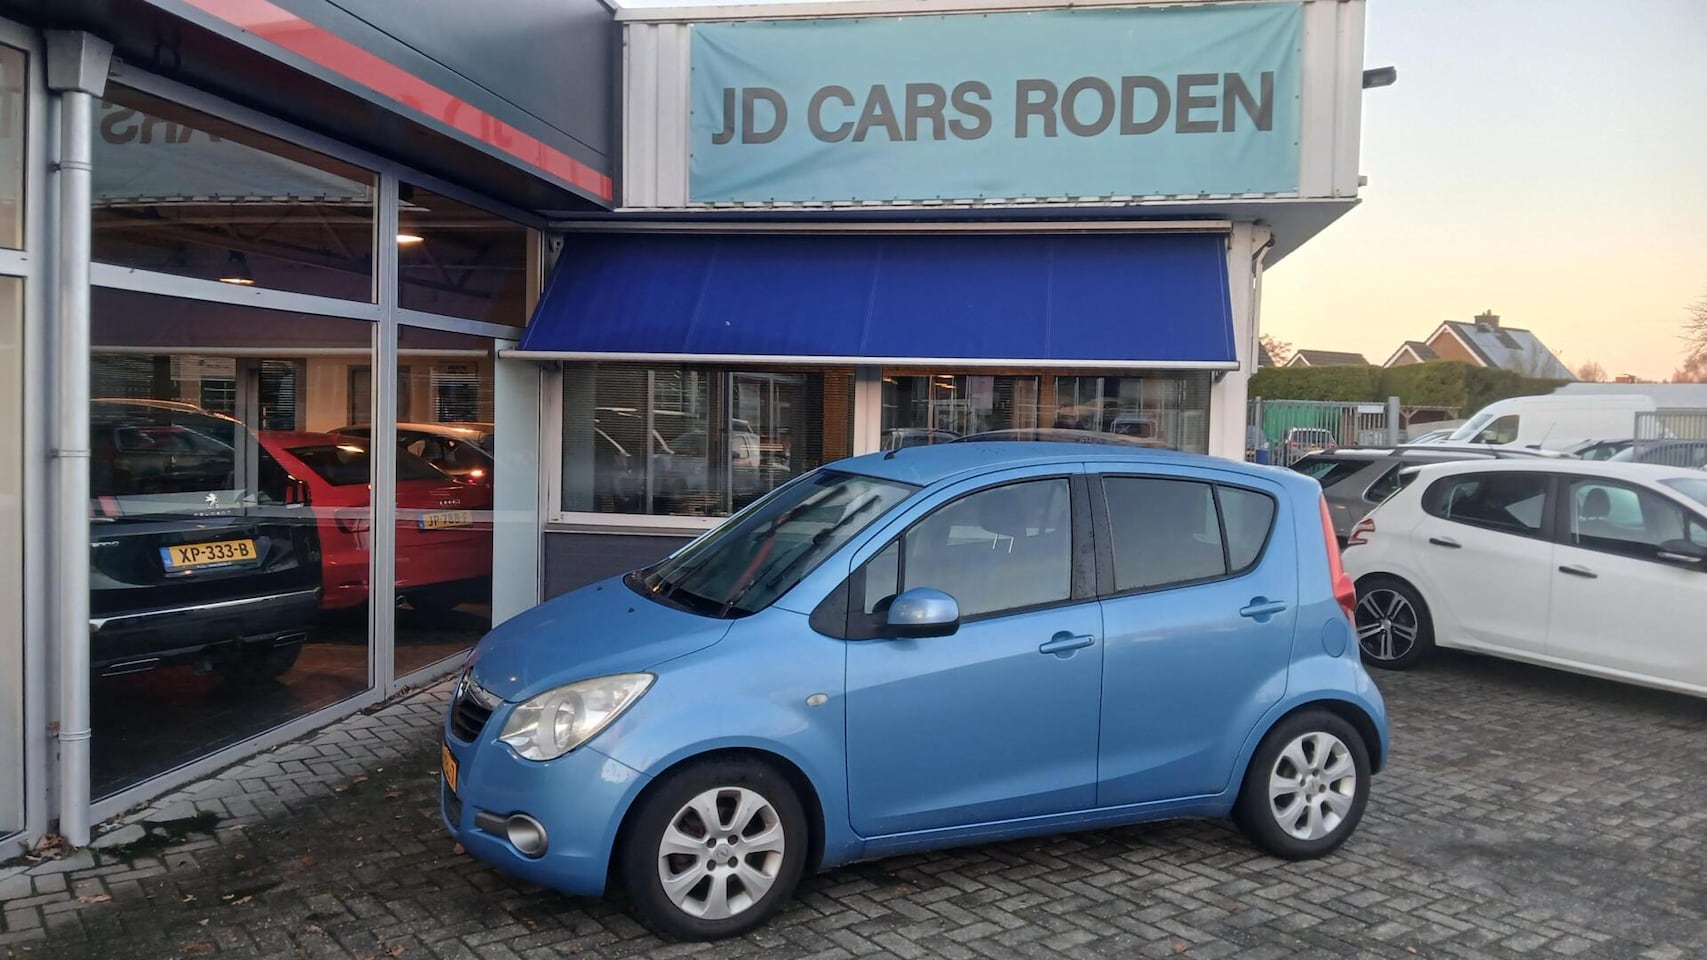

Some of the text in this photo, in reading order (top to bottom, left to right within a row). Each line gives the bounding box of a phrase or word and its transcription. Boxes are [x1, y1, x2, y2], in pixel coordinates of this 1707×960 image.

[711, 71, 1274, 145] JD CARS RODEN
[179, 543, 249, 563] XP-333-B
